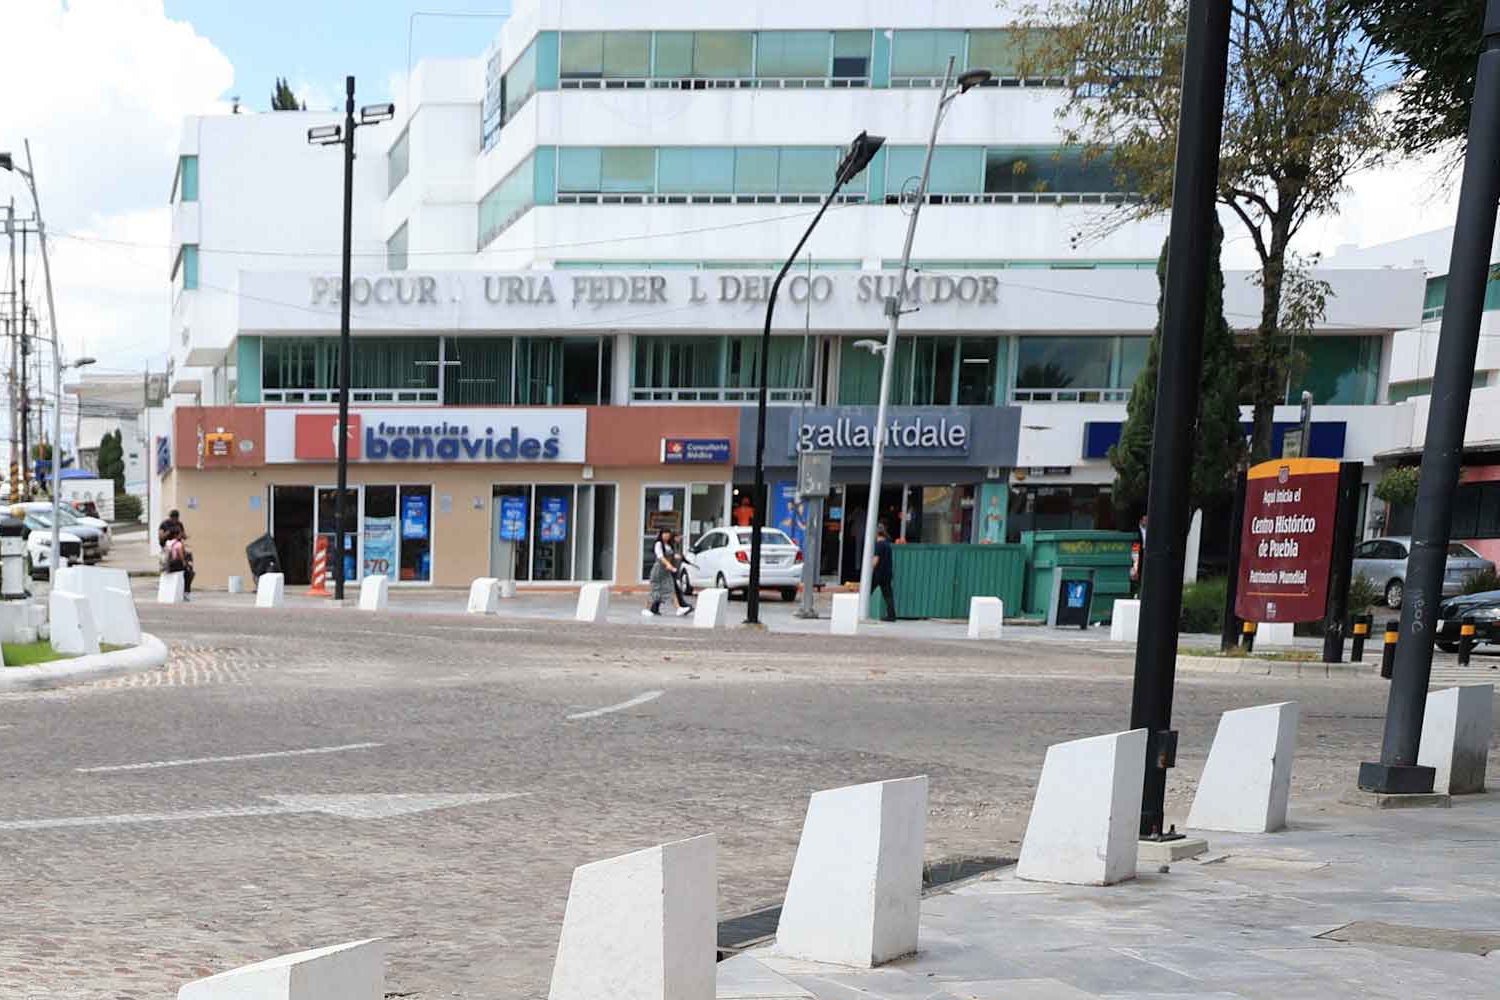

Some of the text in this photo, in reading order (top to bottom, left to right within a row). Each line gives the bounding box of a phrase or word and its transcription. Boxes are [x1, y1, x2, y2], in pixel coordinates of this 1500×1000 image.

[378, 422, 469, 435] farmacias
[365, 426, 560, 460] benavides
[1294, 488, 1302, 502] el
[1251, 514, 1316, 534] Centro Histórico
[1258, 538, 1299, 557] de Puebla
[1278, 569, 1307, 584] Mundial
